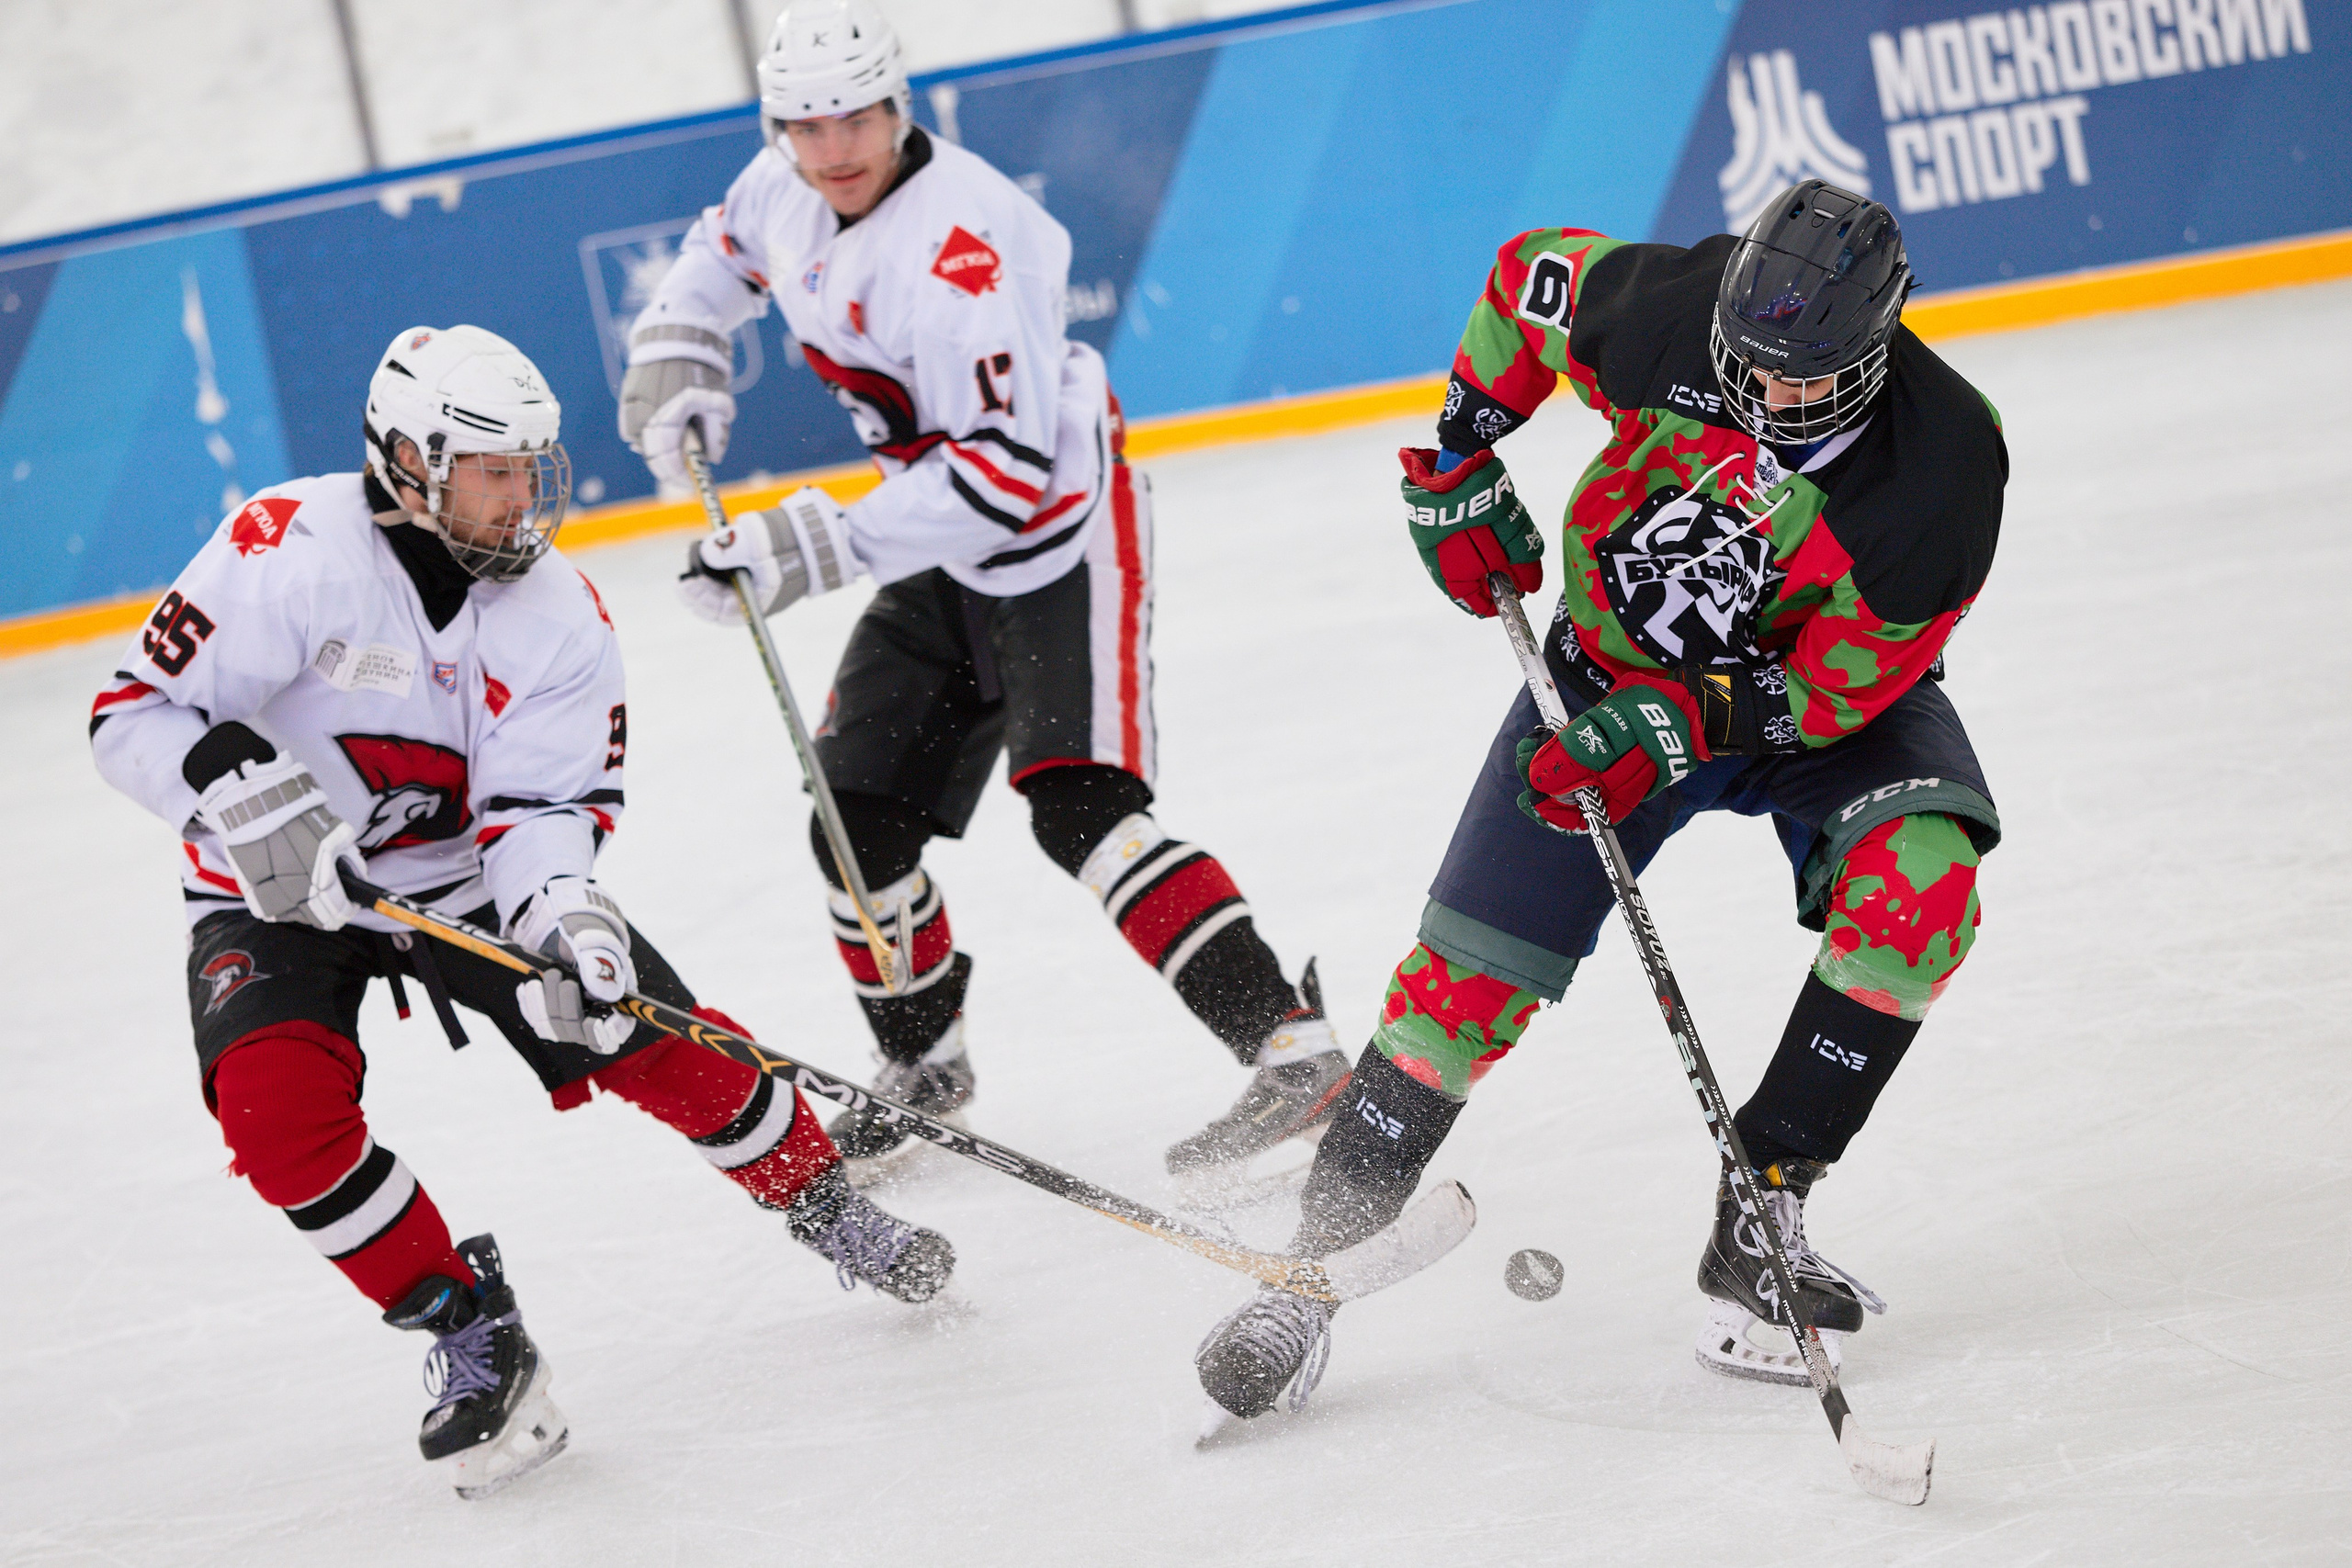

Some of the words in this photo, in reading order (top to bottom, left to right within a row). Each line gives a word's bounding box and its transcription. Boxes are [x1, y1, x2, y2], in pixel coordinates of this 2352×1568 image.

[1885, 96, 2092, 214] СПОРТ
[1740, 334, 1790, 359] BAUER
[142, 590, 218, 679] 95
[1490, 577, 1527, 658] OYUZ
[1611, 712, 1628, 732] BARS
[1637, 703, 1689, 786] BAU
[1839, 777, 1940, 823] CCM
[1630, 892, 1672, 974] SOYUZ
[1664, 1031, 1774, 1258] SOYUZ
[1781, 1300, 1802, 1337] master
